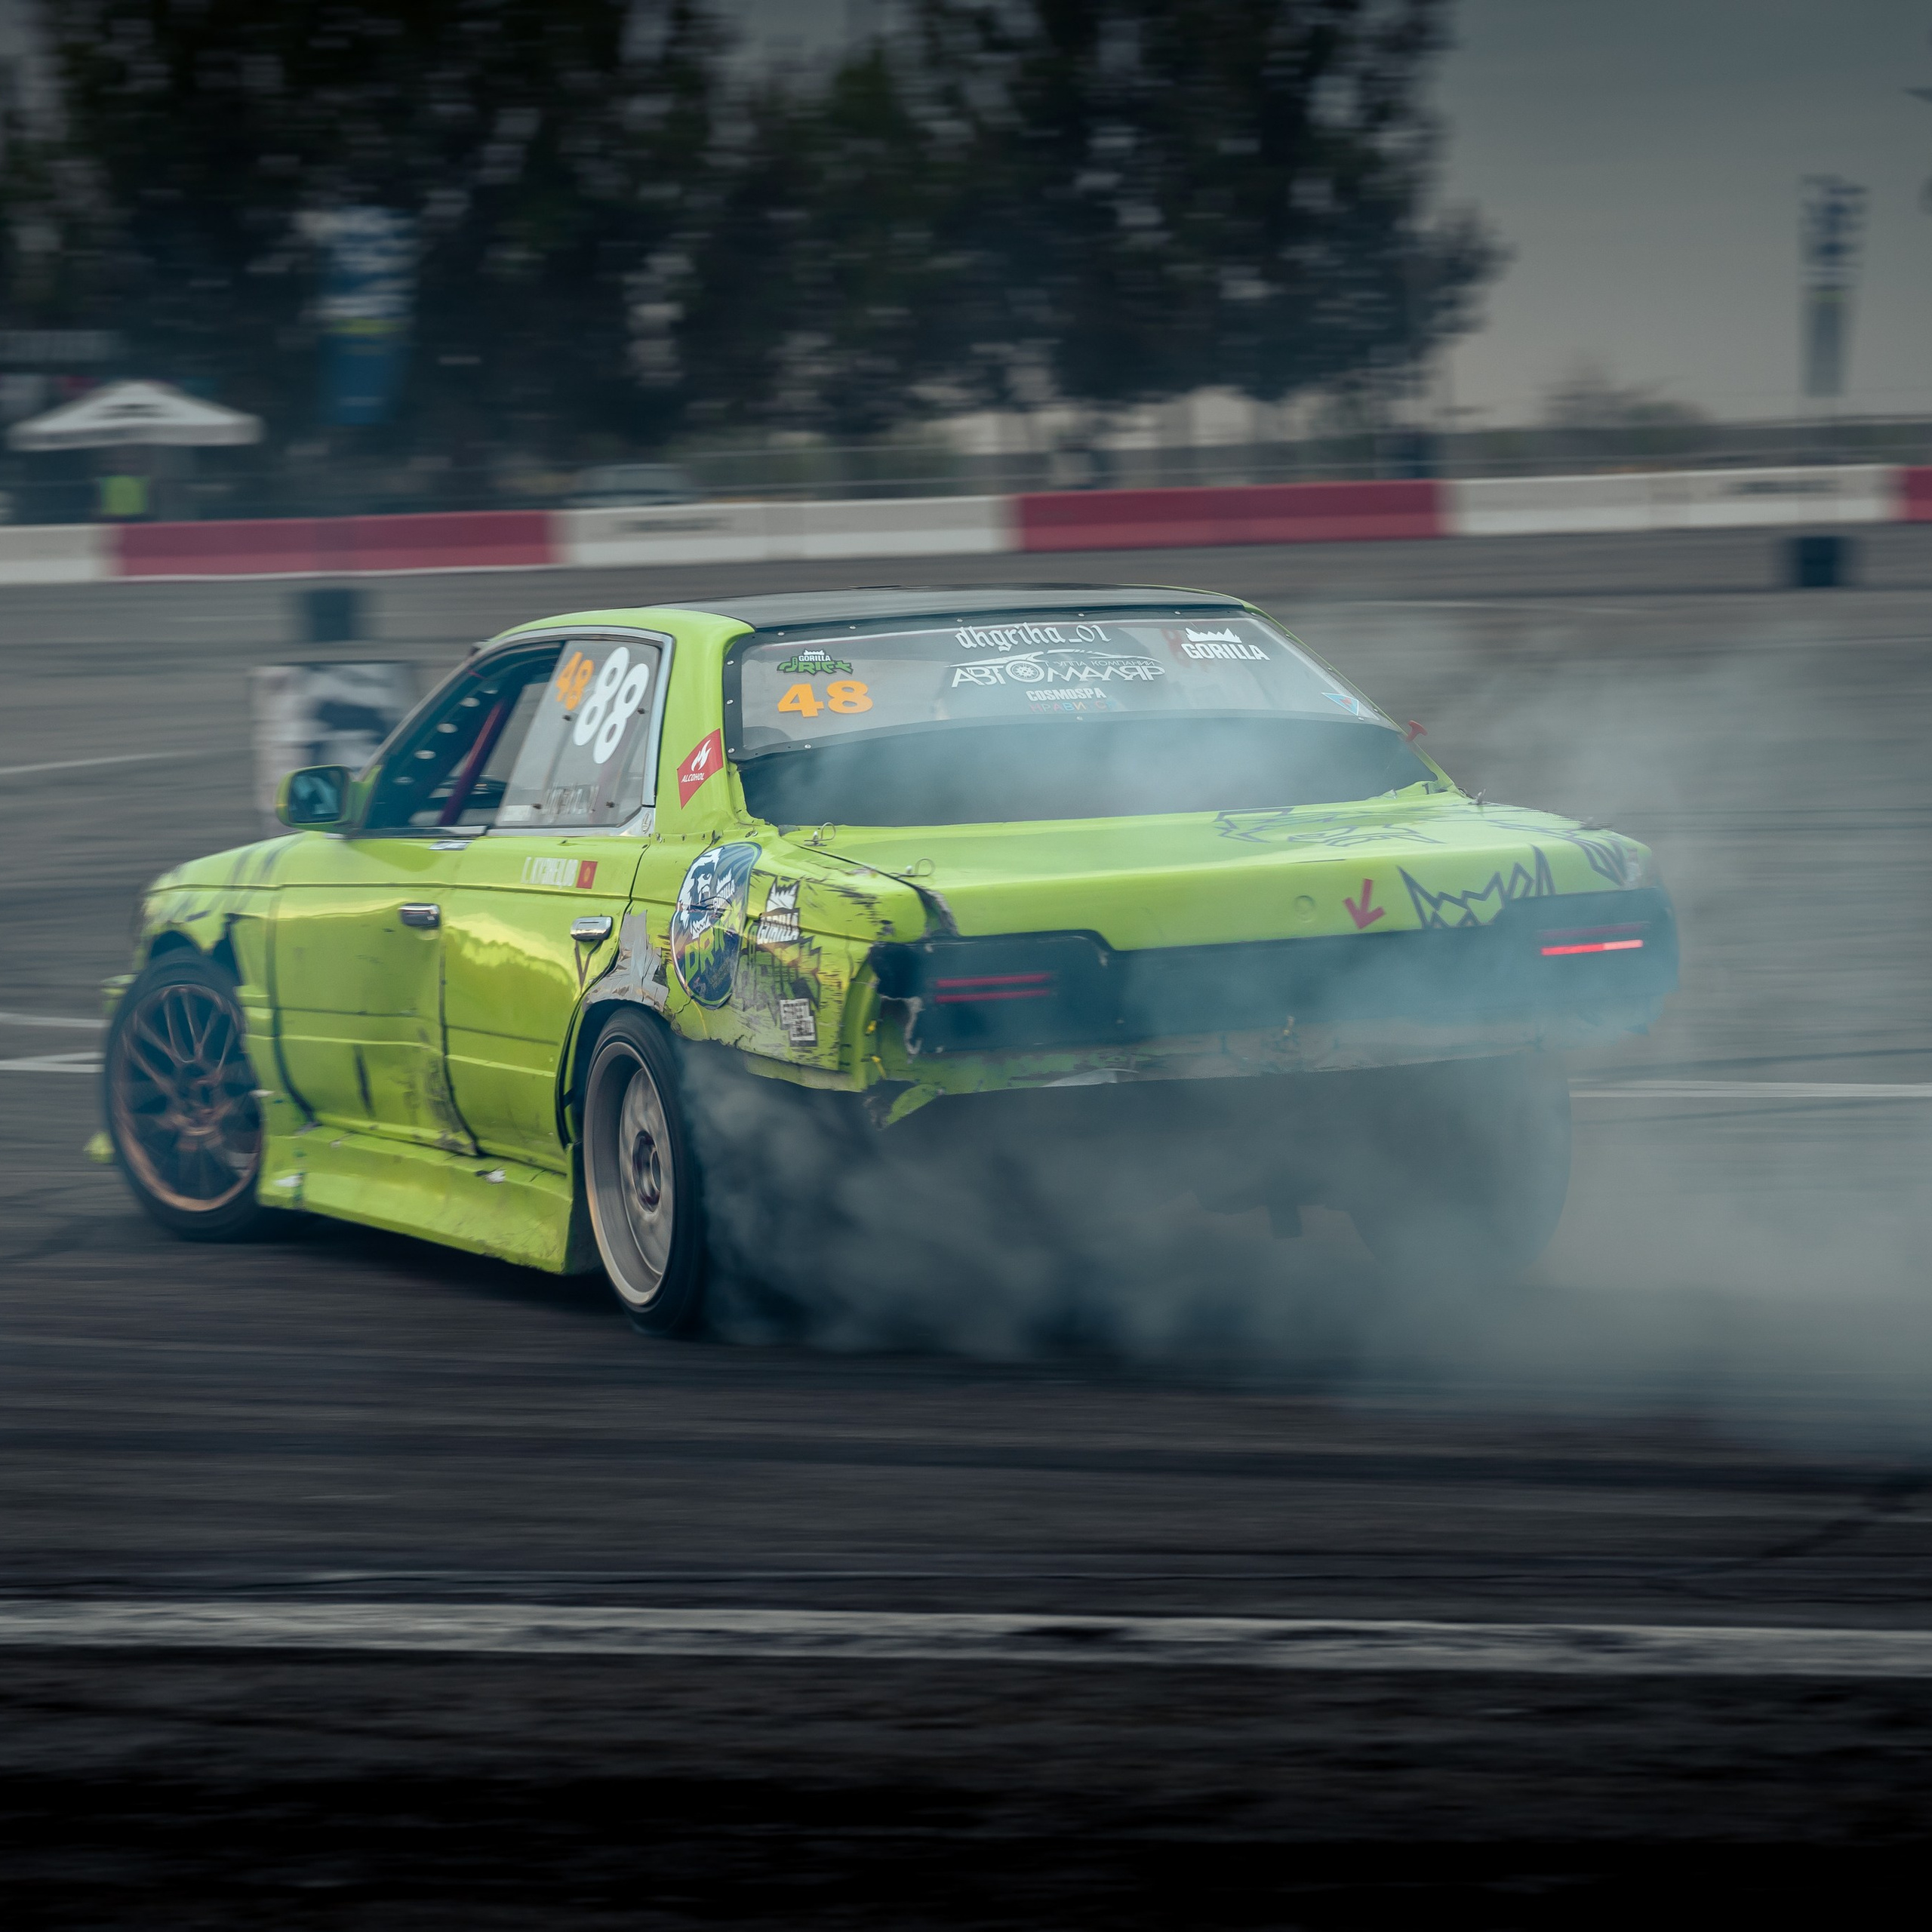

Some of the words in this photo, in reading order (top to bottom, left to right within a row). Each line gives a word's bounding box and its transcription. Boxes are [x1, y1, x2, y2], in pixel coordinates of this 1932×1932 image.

[1181, 643, 1270, 660] GORILLA
[555, 651, 595, 711] 48
[1026, 688, 1107, 701] COSMOSPA
[573, 646, 650, 764] 88
[777, 680, 874, 717] 48
[681, 773, 705, 783] ALCOHOL
